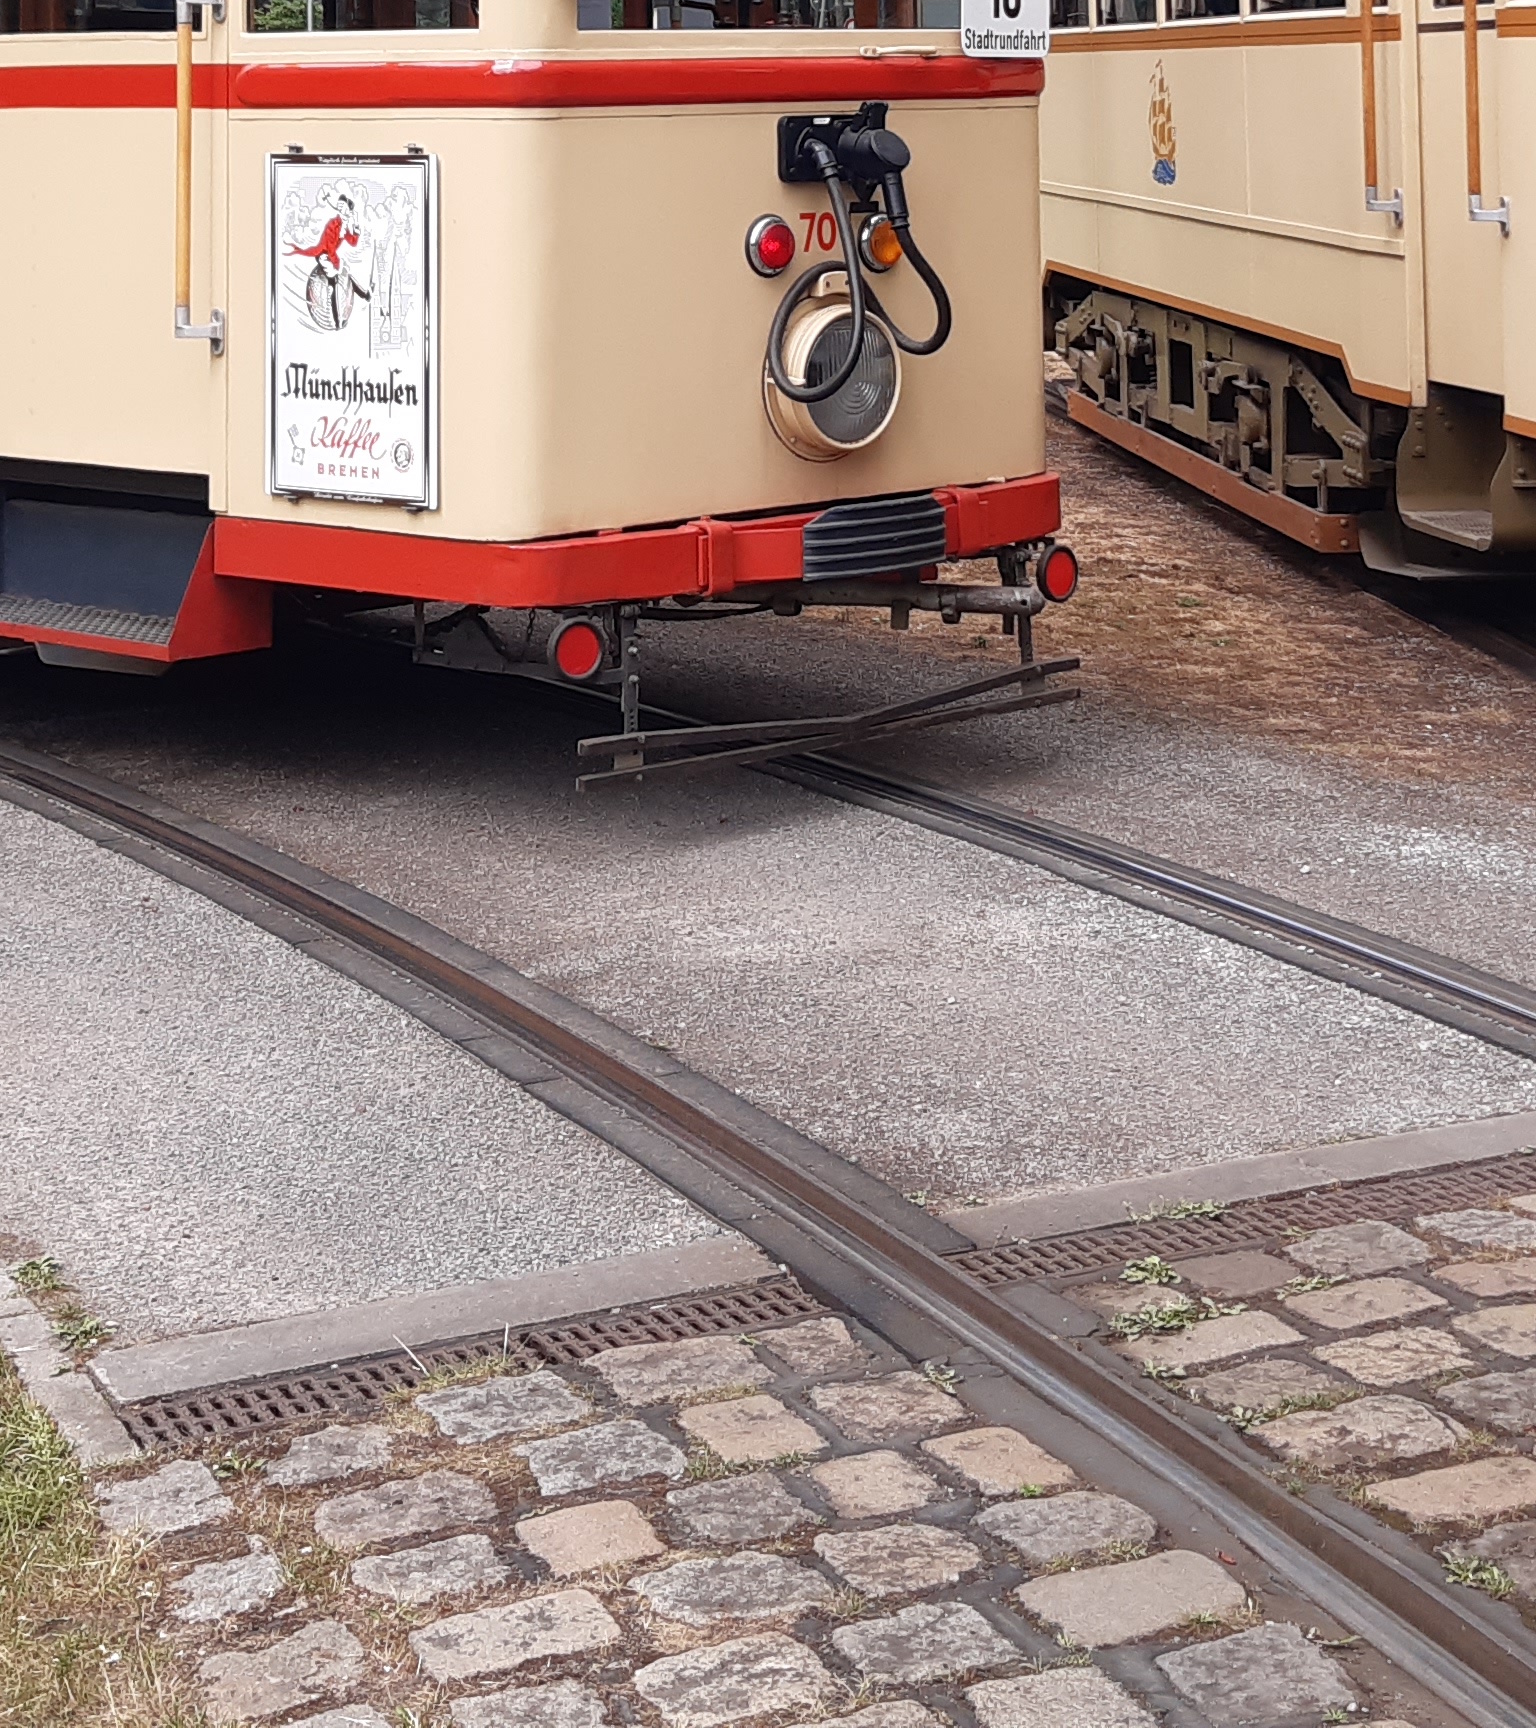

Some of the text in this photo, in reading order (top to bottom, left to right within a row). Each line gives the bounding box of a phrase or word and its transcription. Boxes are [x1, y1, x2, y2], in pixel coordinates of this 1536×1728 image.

[963, 27, 1047, 52] Stadtrundfahrt
[309, 415, 388, 461] Kaffee
[317, 462, 381, 480] BREMEN
